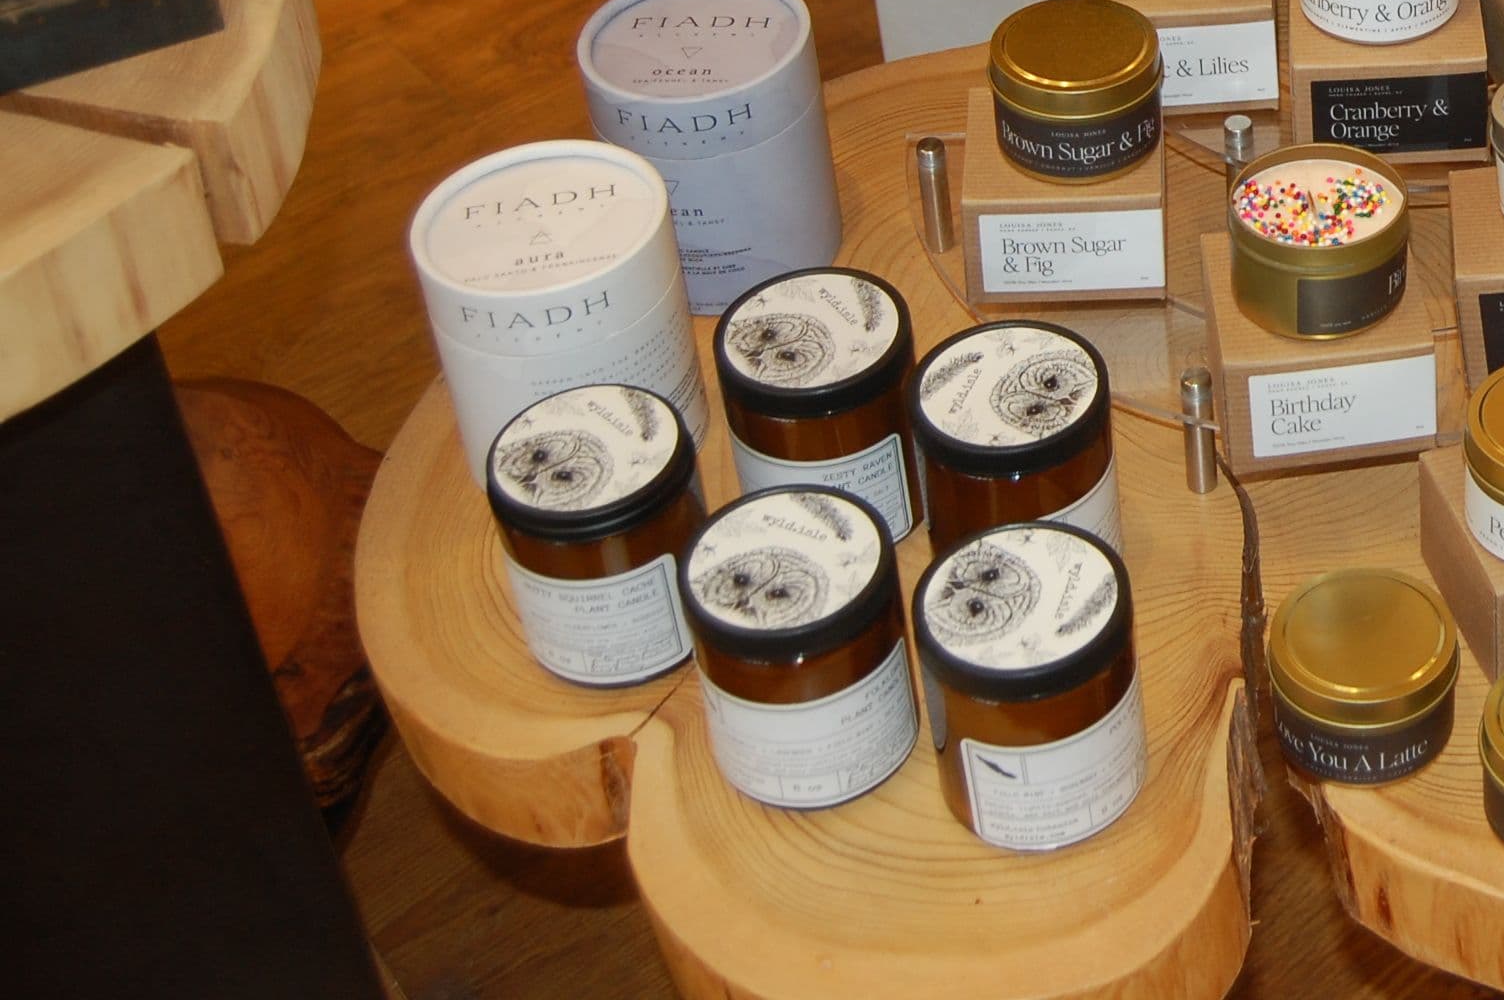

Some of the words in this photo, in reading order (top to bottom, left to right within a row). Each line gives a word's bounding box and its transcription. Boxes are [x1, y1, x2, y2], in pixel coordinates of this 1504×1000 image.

[631, 15, 773, 30] FIADH
[1375, 3, 1393, 23] &
[652, 66, 713, 77] ocean
[1176, 59, 1193, 78] &
[1199, 56, 1250, 77] Lilies
[1328, 86, 1361, 94] LOUISA
[616, 103, 753, 135] FIADH
[1330, 102, 1428, 122] Cranberry
[1432, 98, 1449, 117] &
[1000, 119, 1053, 160] Brown
[1058, 141, 1115, 165] Sugar
[1119, 130, 1134, 151] &
[1051, 130, 1079, 138] LOUISA
[1083, 128, 1107, 137] JONES
[1330, 122, 1400, 142] Orange
[465, 184, 616, 220] FIADH
[1002, 238, 1067, 256] Brown
[1071, 236, 1127, 257] Sugar
[514, 250, 566, 267] aura
[1003, 256, 1020, 274] &
[1025, 256, 1055, 277] Fig
[461, 289, 611, 331] FIADH
[1267, 381, 1302, 389] LOUISA
[1306, 377, 1335, 386] JONES
[1270, 393, 1357, 418] Birthday
[1271, 416, 1322, 437] Cake
[862, 451, 893, 472] RAVEN
[761, 512, 829, 542] wyld.isle
[557, 591, 613, 604] SQUIRREL
[620, 579, 656, 596] CACHE
[574, 603, 610, 615] PLANT
[617, 590, 658, 610] CANDLE
[1308, 741, 1348, 771] You
[1354, 754, 1372, 772] A
[1379, 738, 1429, 770] Latte
[1343, 743, 1370, 751] JONES
